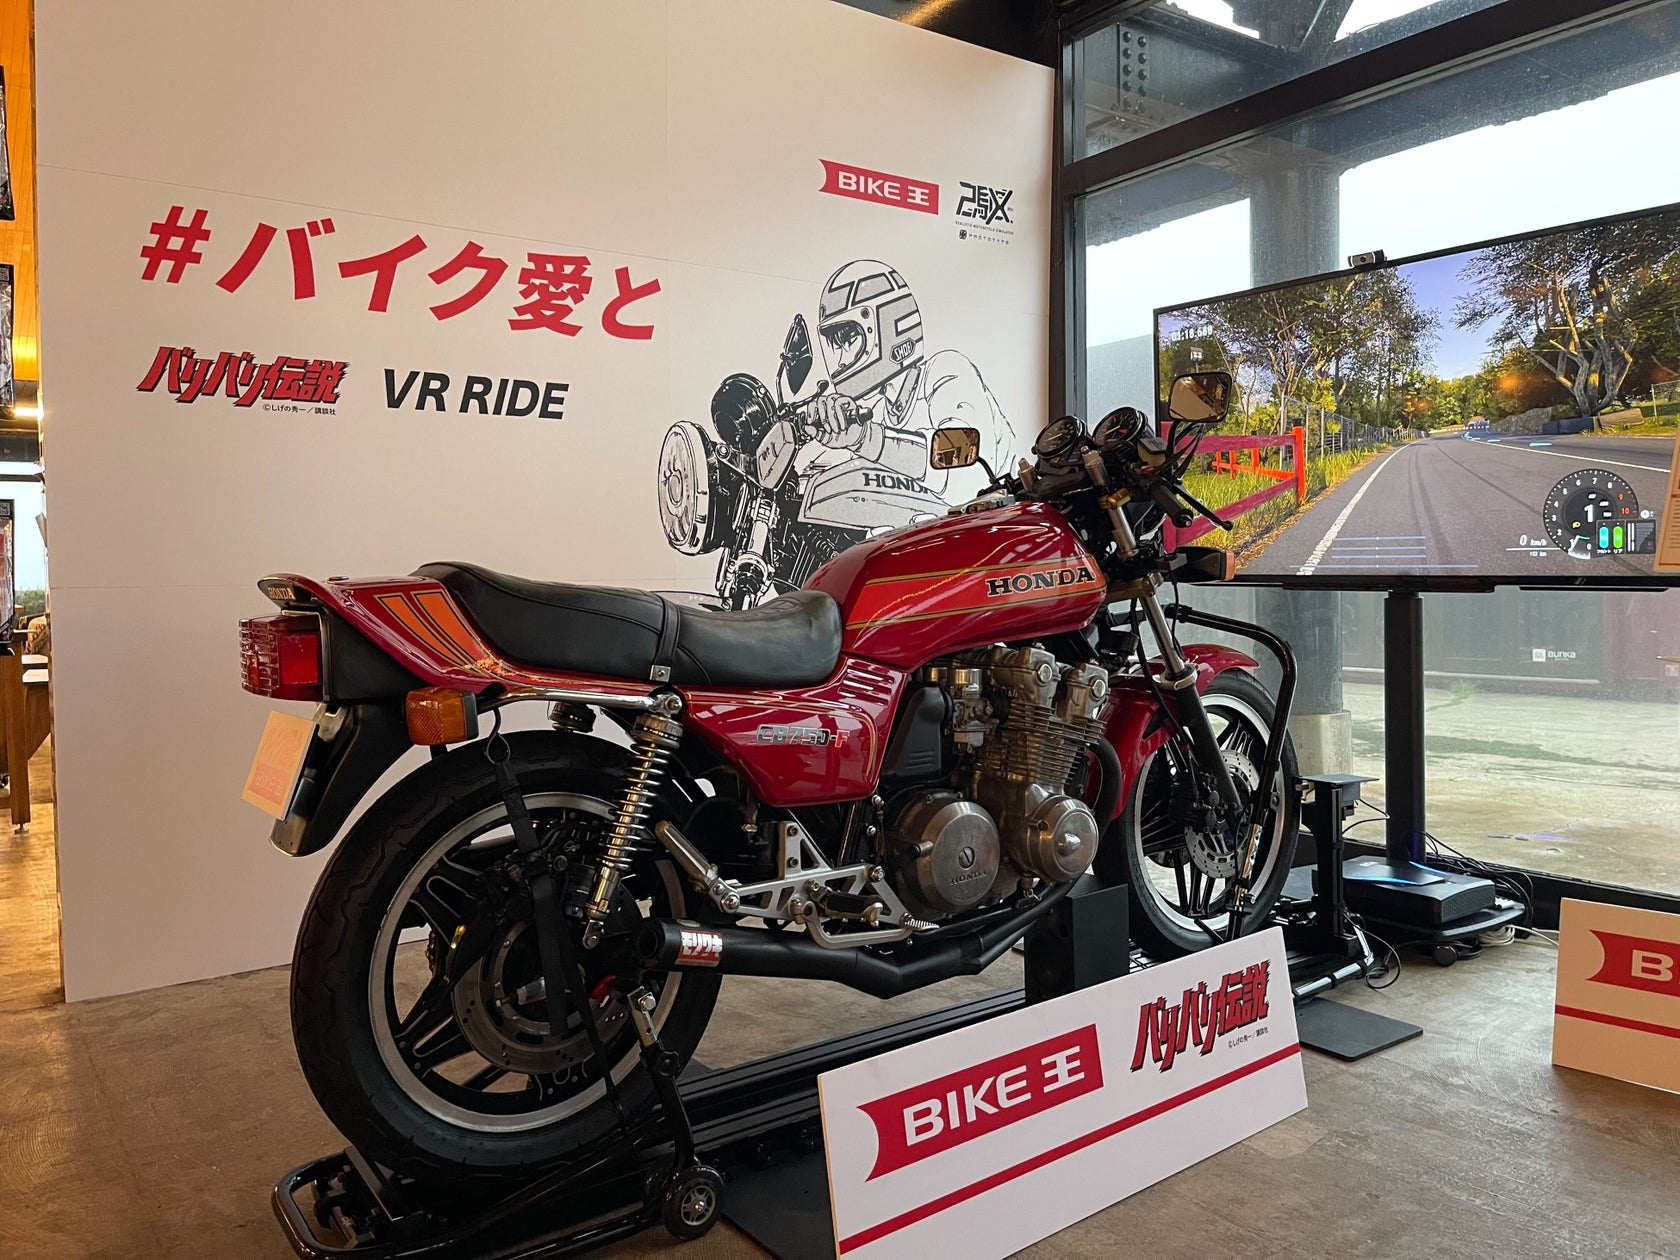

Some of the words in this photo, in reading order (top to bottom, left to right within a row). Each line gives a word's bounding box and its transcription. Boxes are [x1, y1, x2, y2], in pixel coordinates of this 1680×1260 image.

[838, 170, 901, 201] BIKE
[906, 185, 930, 207] 王
[139, 204, 663, 342] #バイク愛と
[136, 345, 350, 408] バリバリ伝説
[384, 369, 450, 413] VR
[458, 375, 570, 420] RIDE
[1584, 504, 1594, 523] 1
[1621, 507, 1630, 515] 10
[1519, 534, 1528, 547] 0
[267, 586, 296, 600] HONDA
[986, 566, 1096, 597] HONDA
[681, 931, 723, 957] モリワキ
[1631, 949, 1680, 984] B
[1130, 959, 1271, 1073] バリバリ伝説
[903, 1066, 1031, 1146] BIKE
[1042, 1046, 1085, 1094] 王
